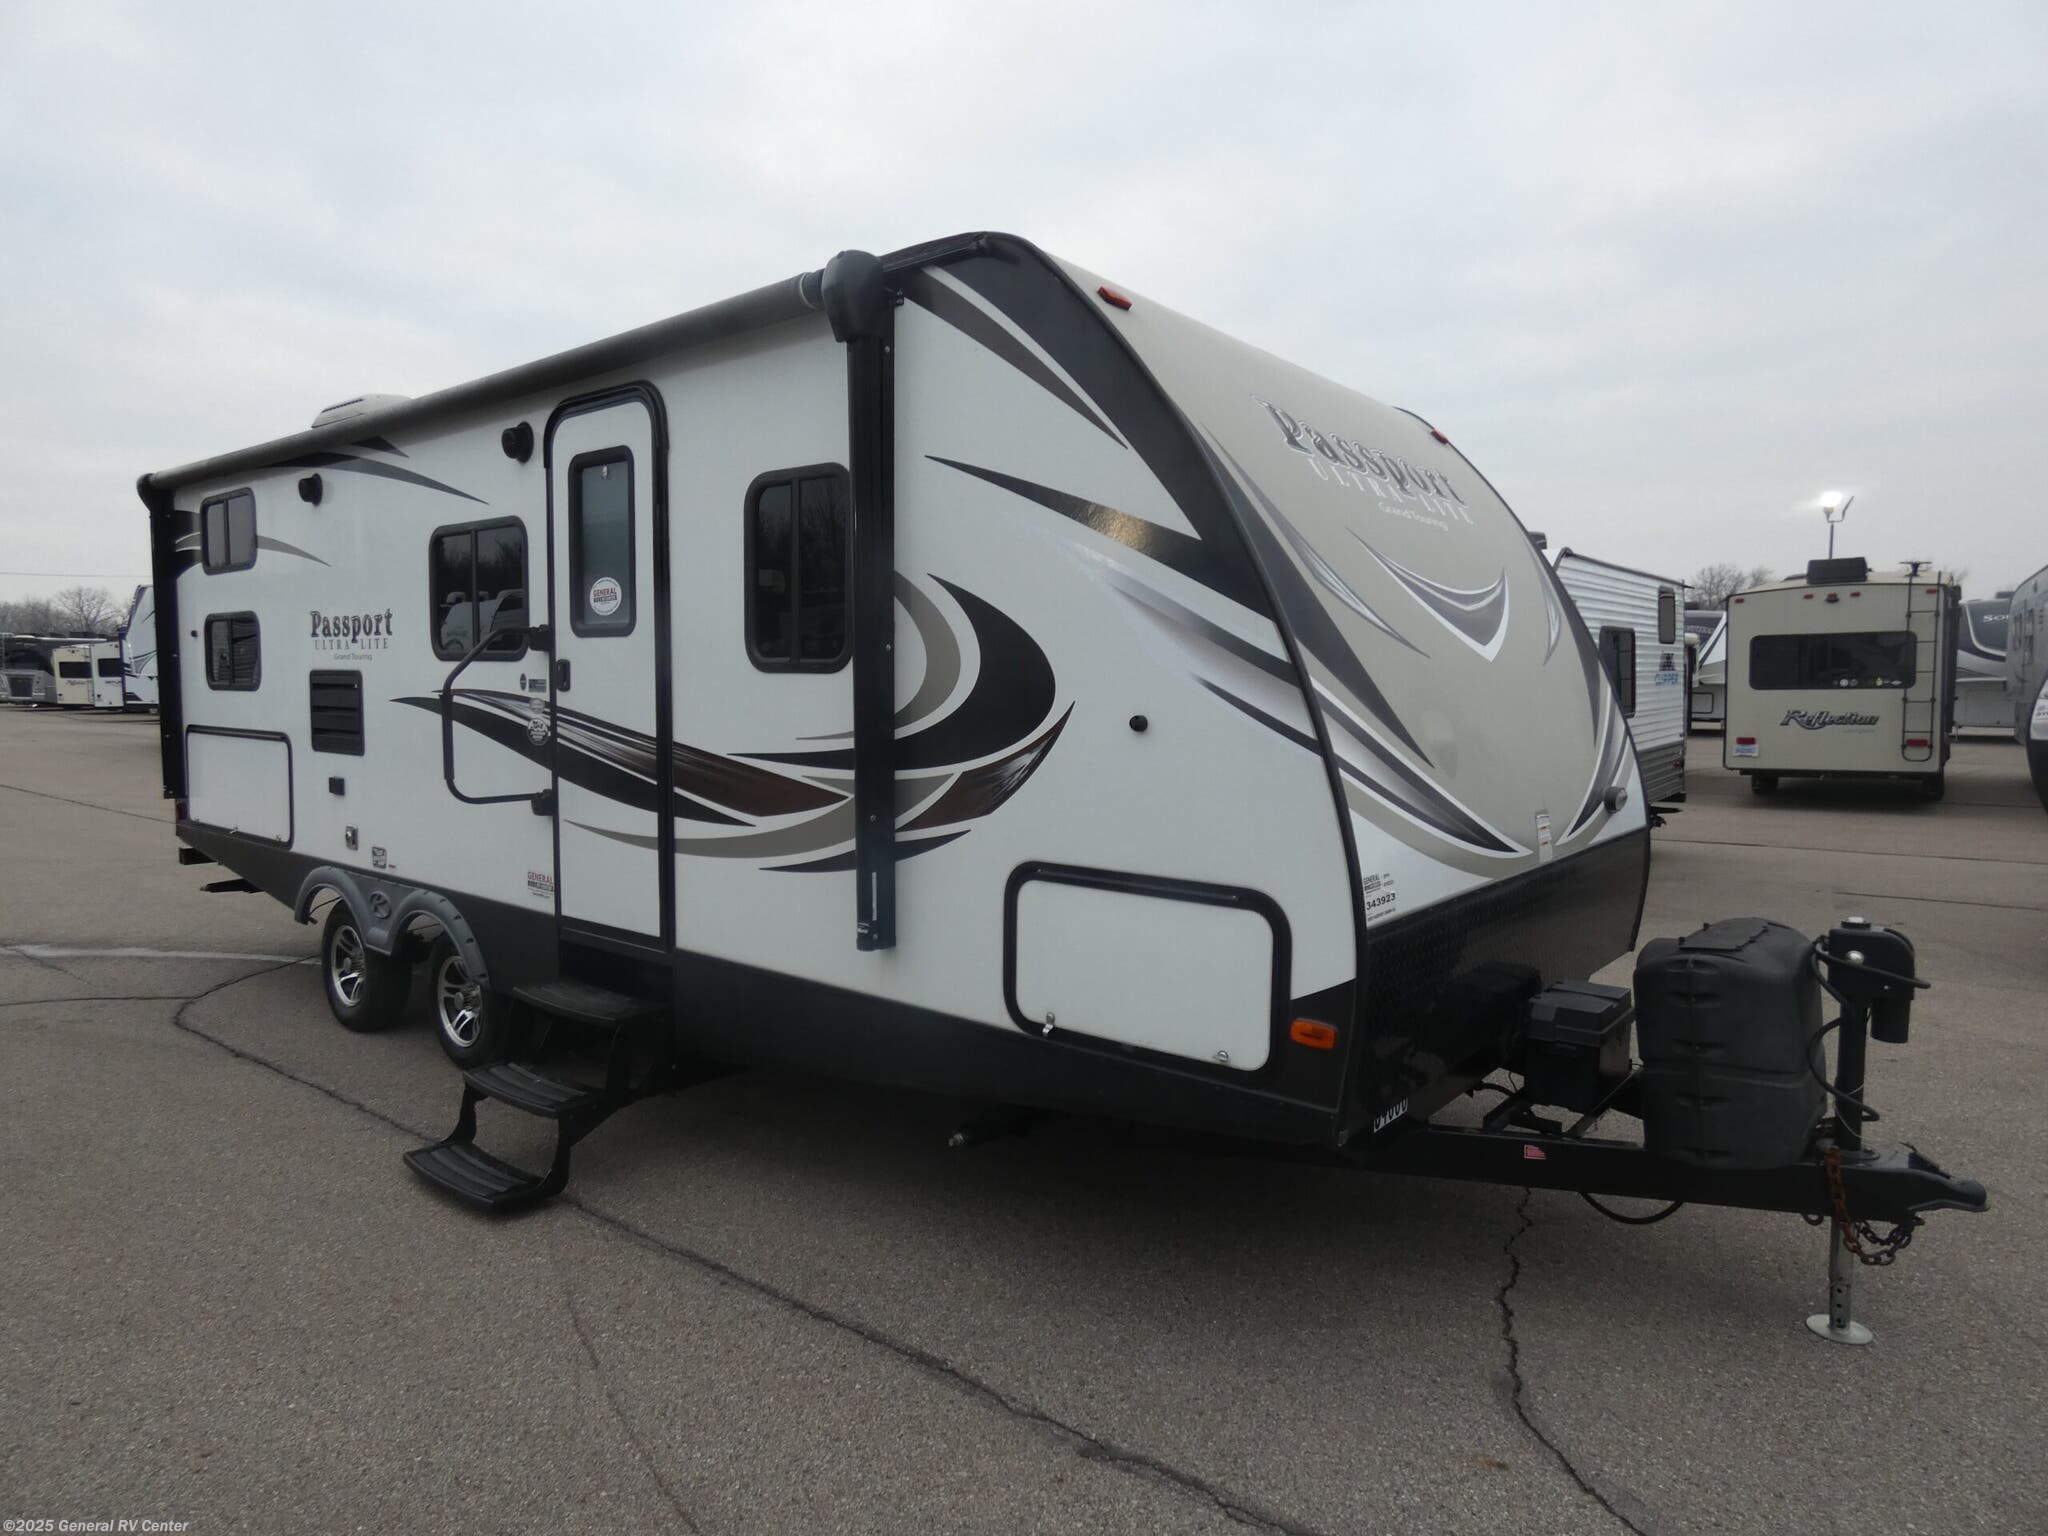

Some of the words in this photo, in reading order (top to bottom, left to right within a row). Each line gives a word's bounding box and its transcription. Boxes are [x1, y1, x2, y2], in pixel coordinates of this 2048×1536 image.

[1252, 395, 1467, 505] Passport
[310, 608, 393, 643] Passport
[314, 639, 350, 650] ULTRA
[360, 638, 389, 649] LITE
[1780, 709, 1880, 731] Reflection
[1366, 892, 1396, 911] 343923
